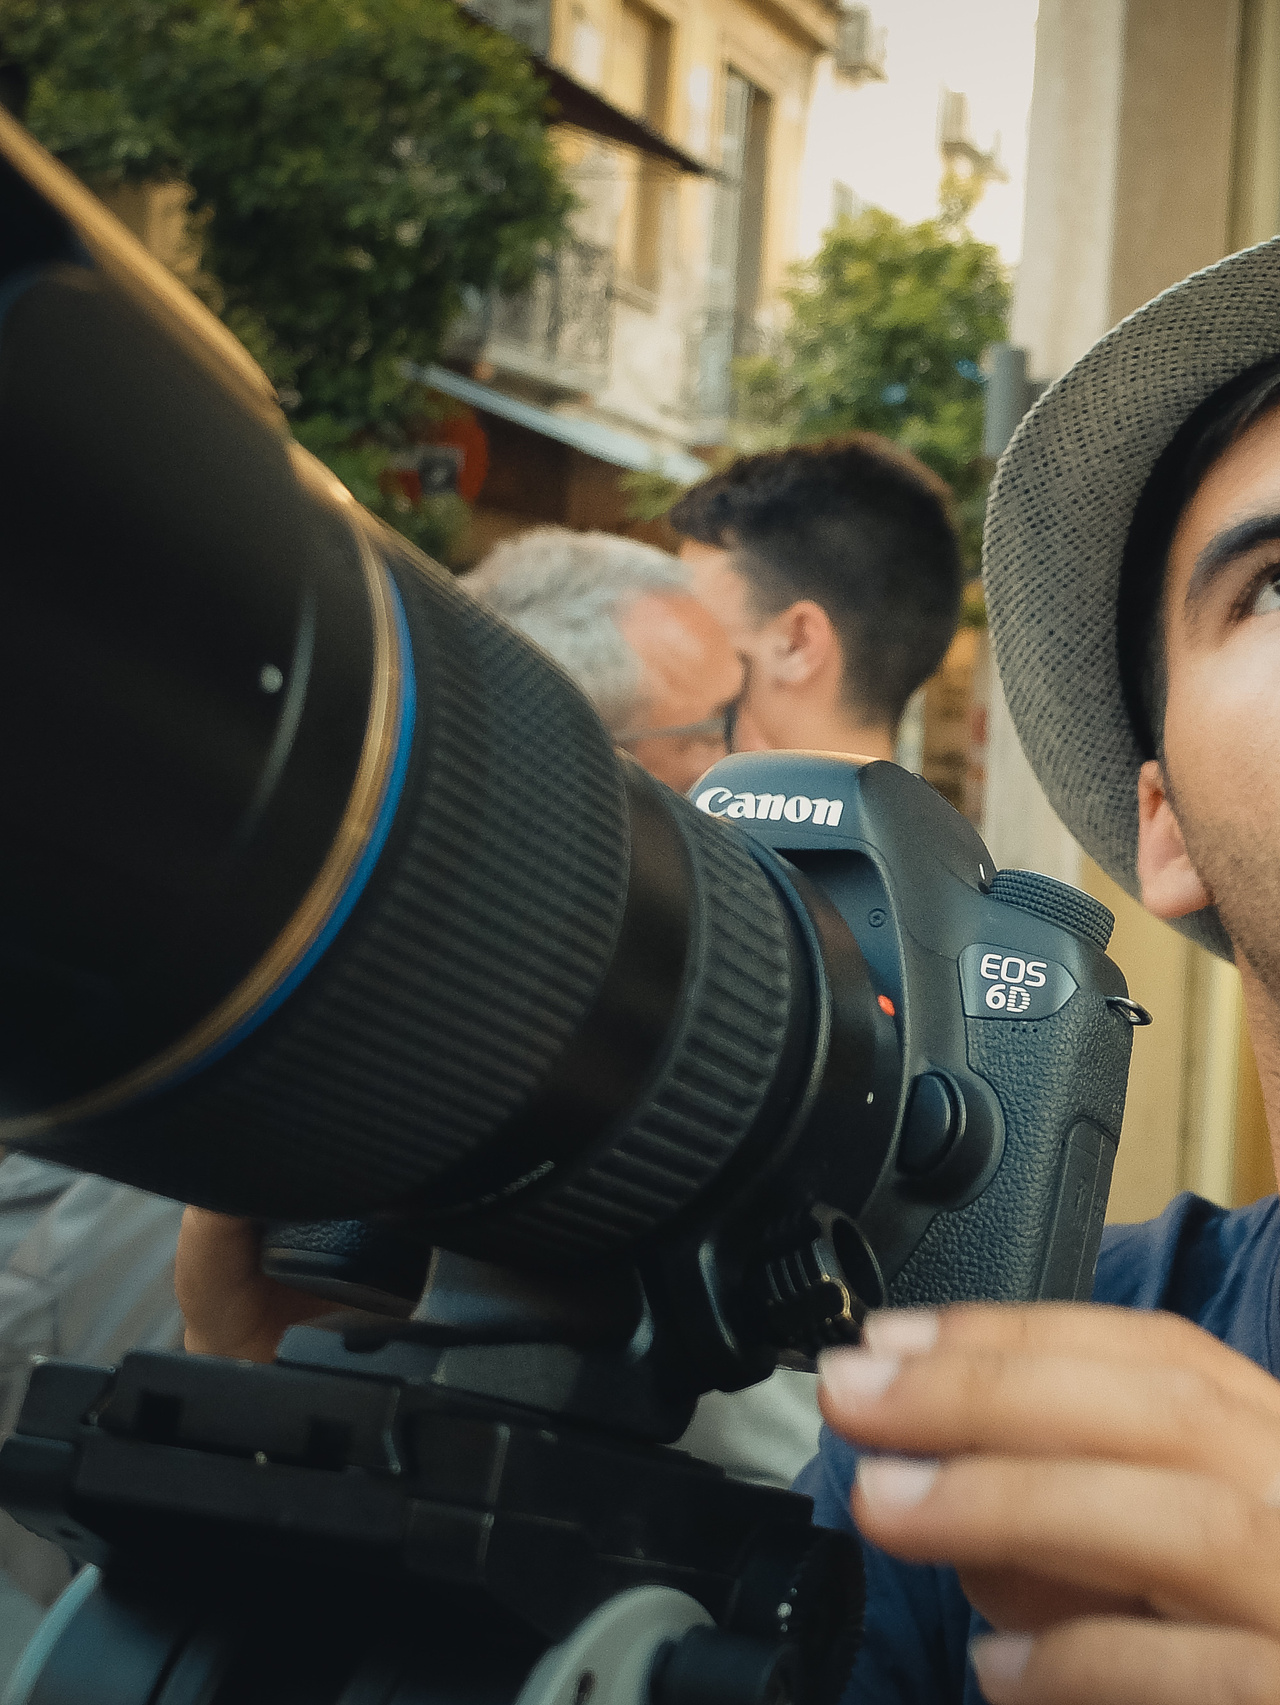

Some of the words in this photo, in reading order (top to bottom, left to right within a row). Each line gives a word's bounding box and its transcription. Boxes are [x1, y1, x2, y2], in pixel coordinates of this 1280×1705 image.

[696, 787, 844, 827] Canon
[980, 953, 1048, 988] EOS
[985, 983, 1031, 1013] 6D
